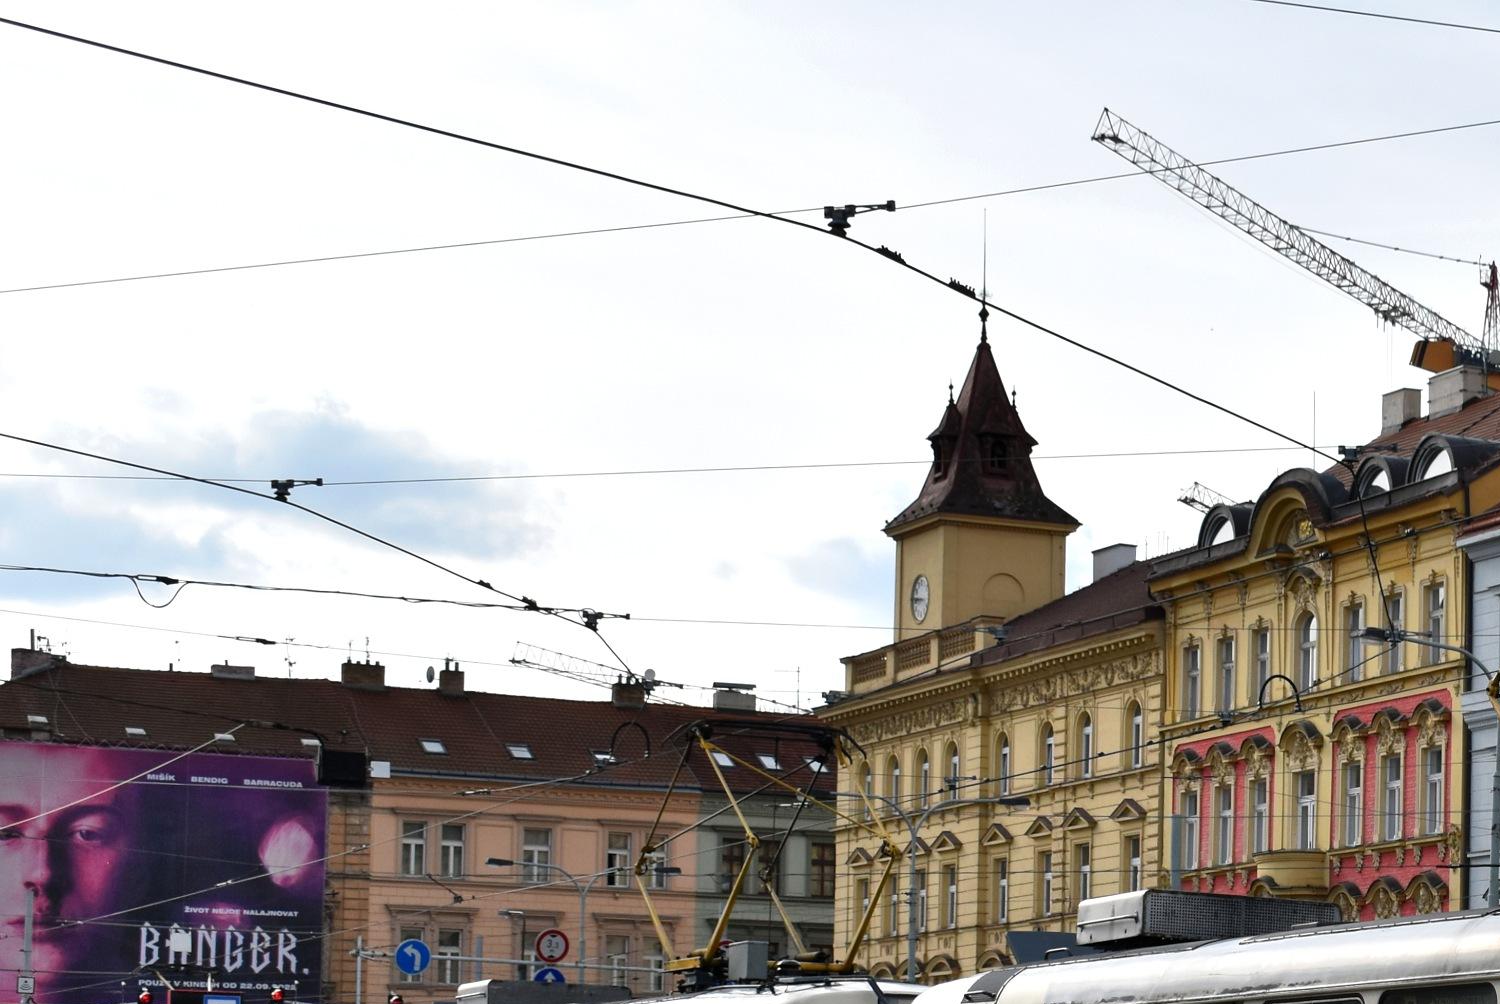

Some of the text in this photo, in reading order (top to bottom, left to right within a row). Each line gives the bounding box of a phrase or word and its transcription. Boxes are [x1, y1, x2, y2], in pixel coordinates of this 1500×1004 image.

[191, 776, 228, 784] BENDIG
[243, 779, 303, 788] BARRACUDA
[184, 905, 209, 914] ŽIVOT
[243, 909, 299, 917] NALAJNOVAT
[223, 982, 237, 990] OD
